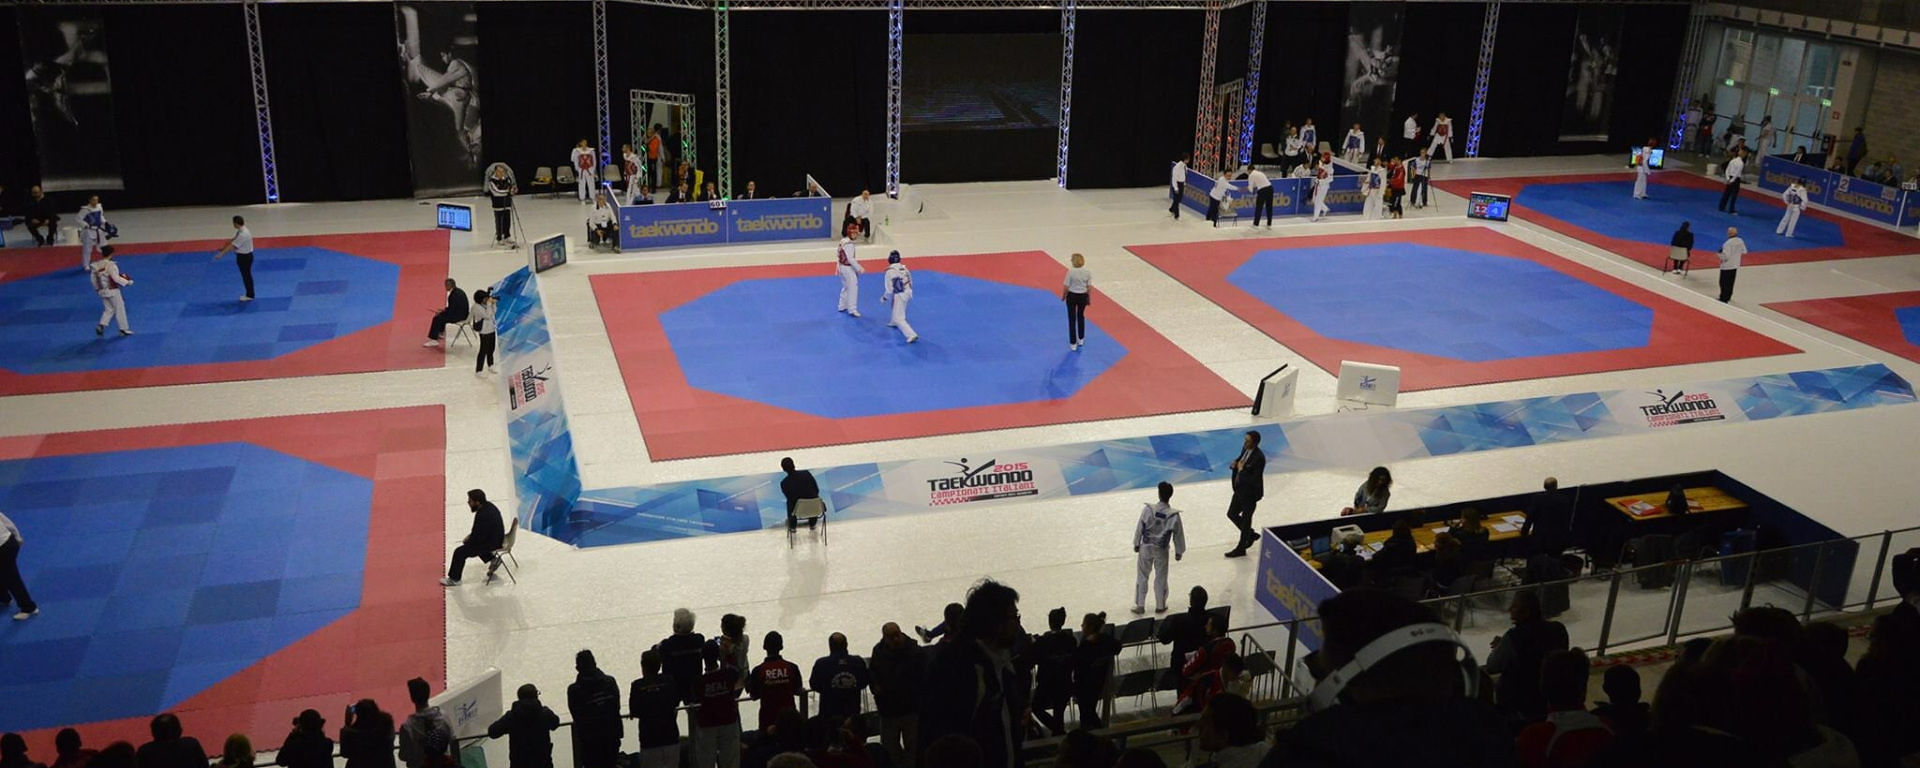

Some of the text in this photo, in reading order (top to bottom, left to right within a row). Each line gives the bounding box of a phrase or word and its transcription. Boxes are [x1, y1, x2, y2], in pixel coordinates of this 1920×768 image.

[629, 218, 719, 238] taekwondo
[736, 213, 823, 232] taekwondo
[1684, 393, 1709, 401] 2015
[993, 462, 1028, 473] 2015
[930, 486, 990, 499] CAMPIONATI
[992, 481, 1035, 493] ITALIANI
[765, 668, 788, 679] REAL
